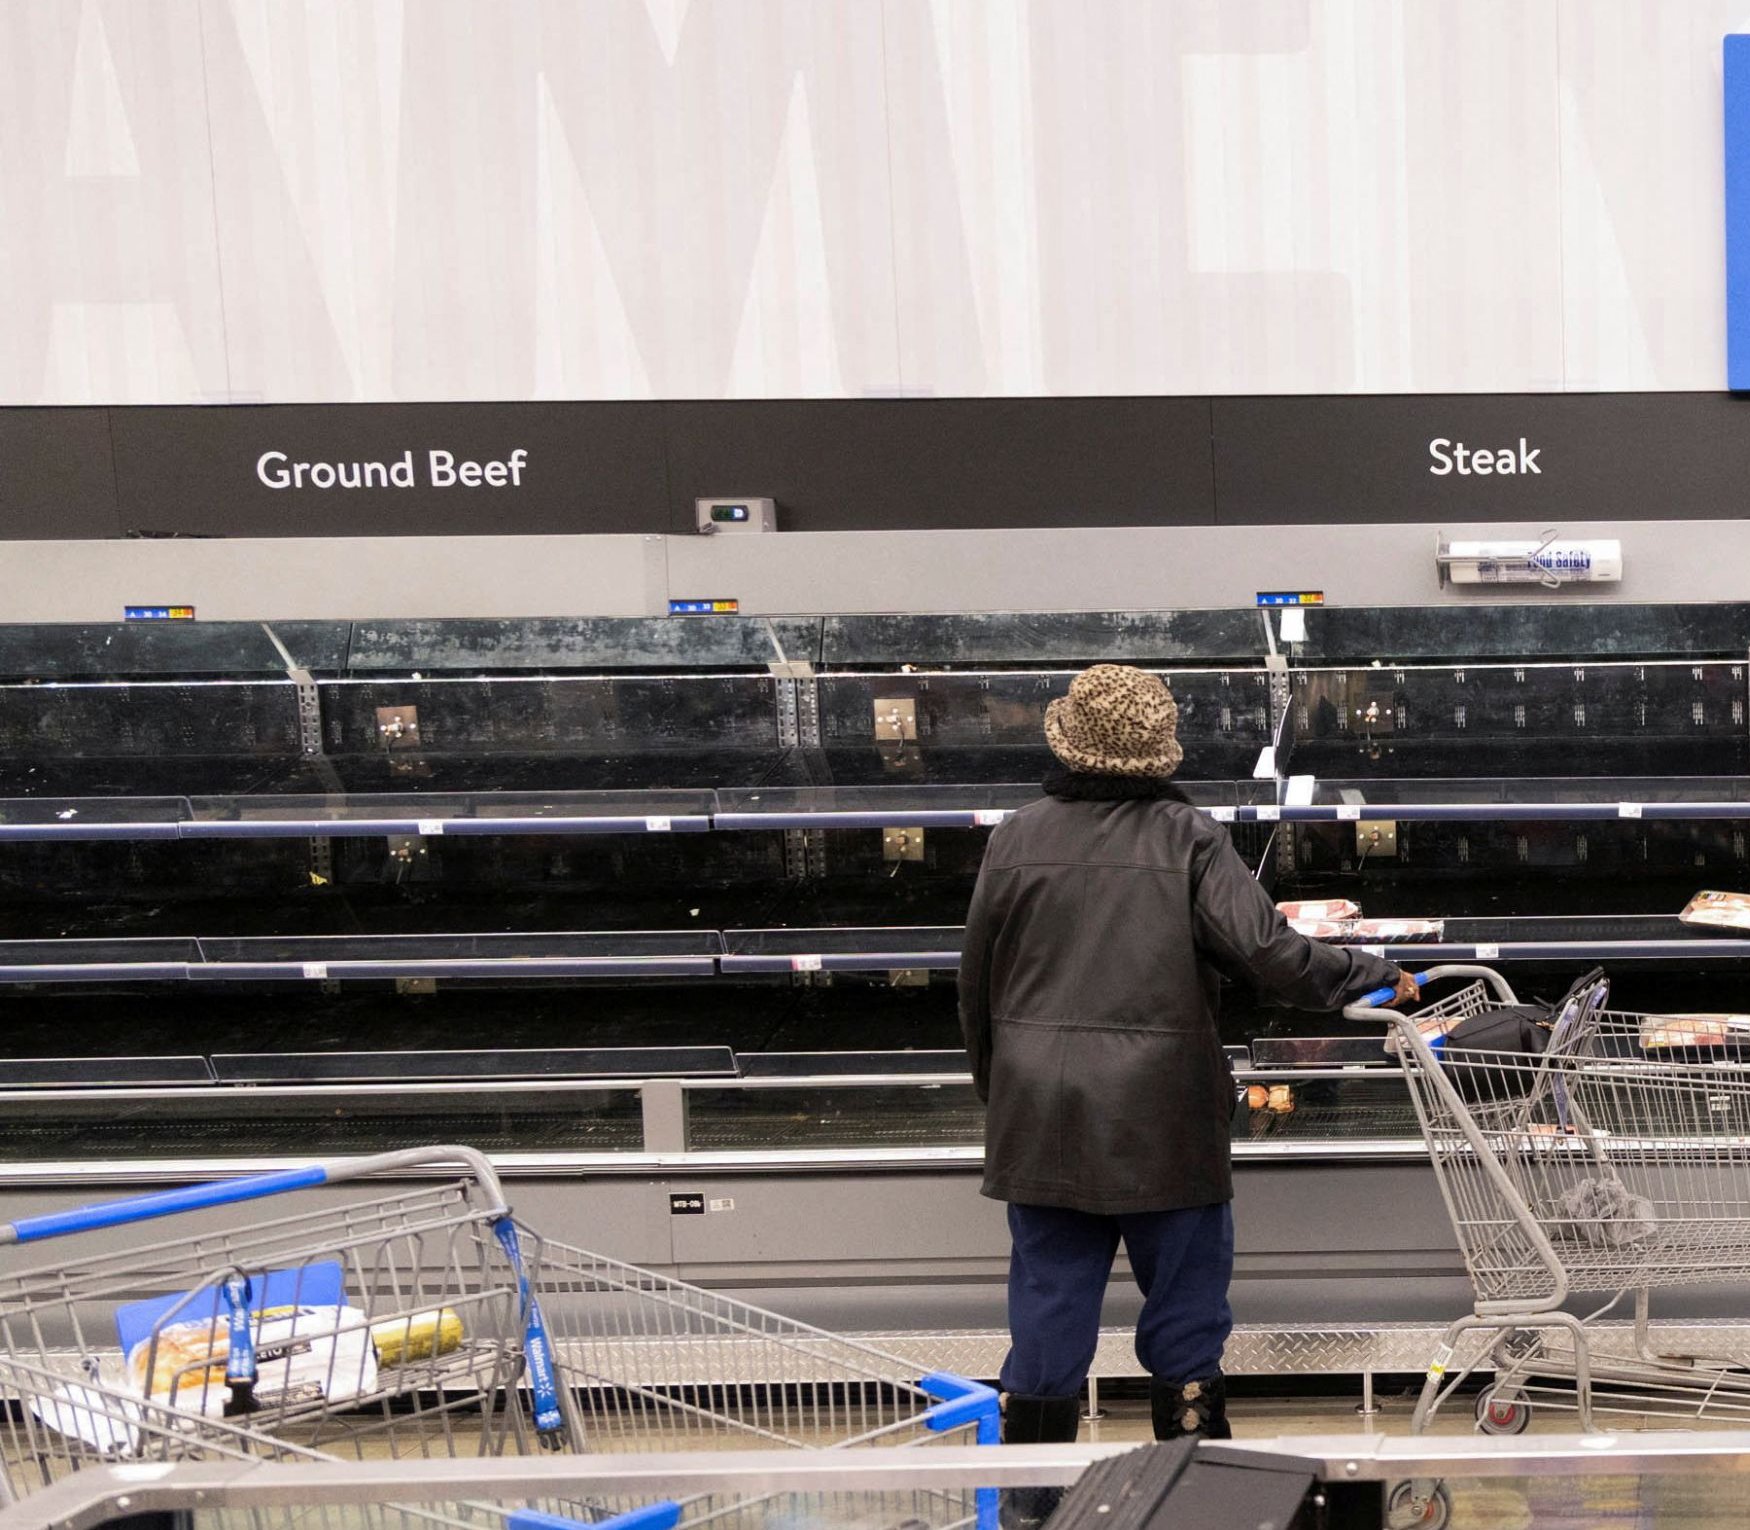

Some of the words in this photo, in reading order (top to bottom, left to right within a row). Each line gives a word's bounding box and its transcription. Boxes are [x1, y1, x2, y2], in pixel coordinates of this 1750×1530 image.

[257, 449, 415, 489] Ground
[428, 448, 528, 487] Beef
[1429, 437, 1542, 476] Steak
[530, 1336, 549, 1383] Walmart
